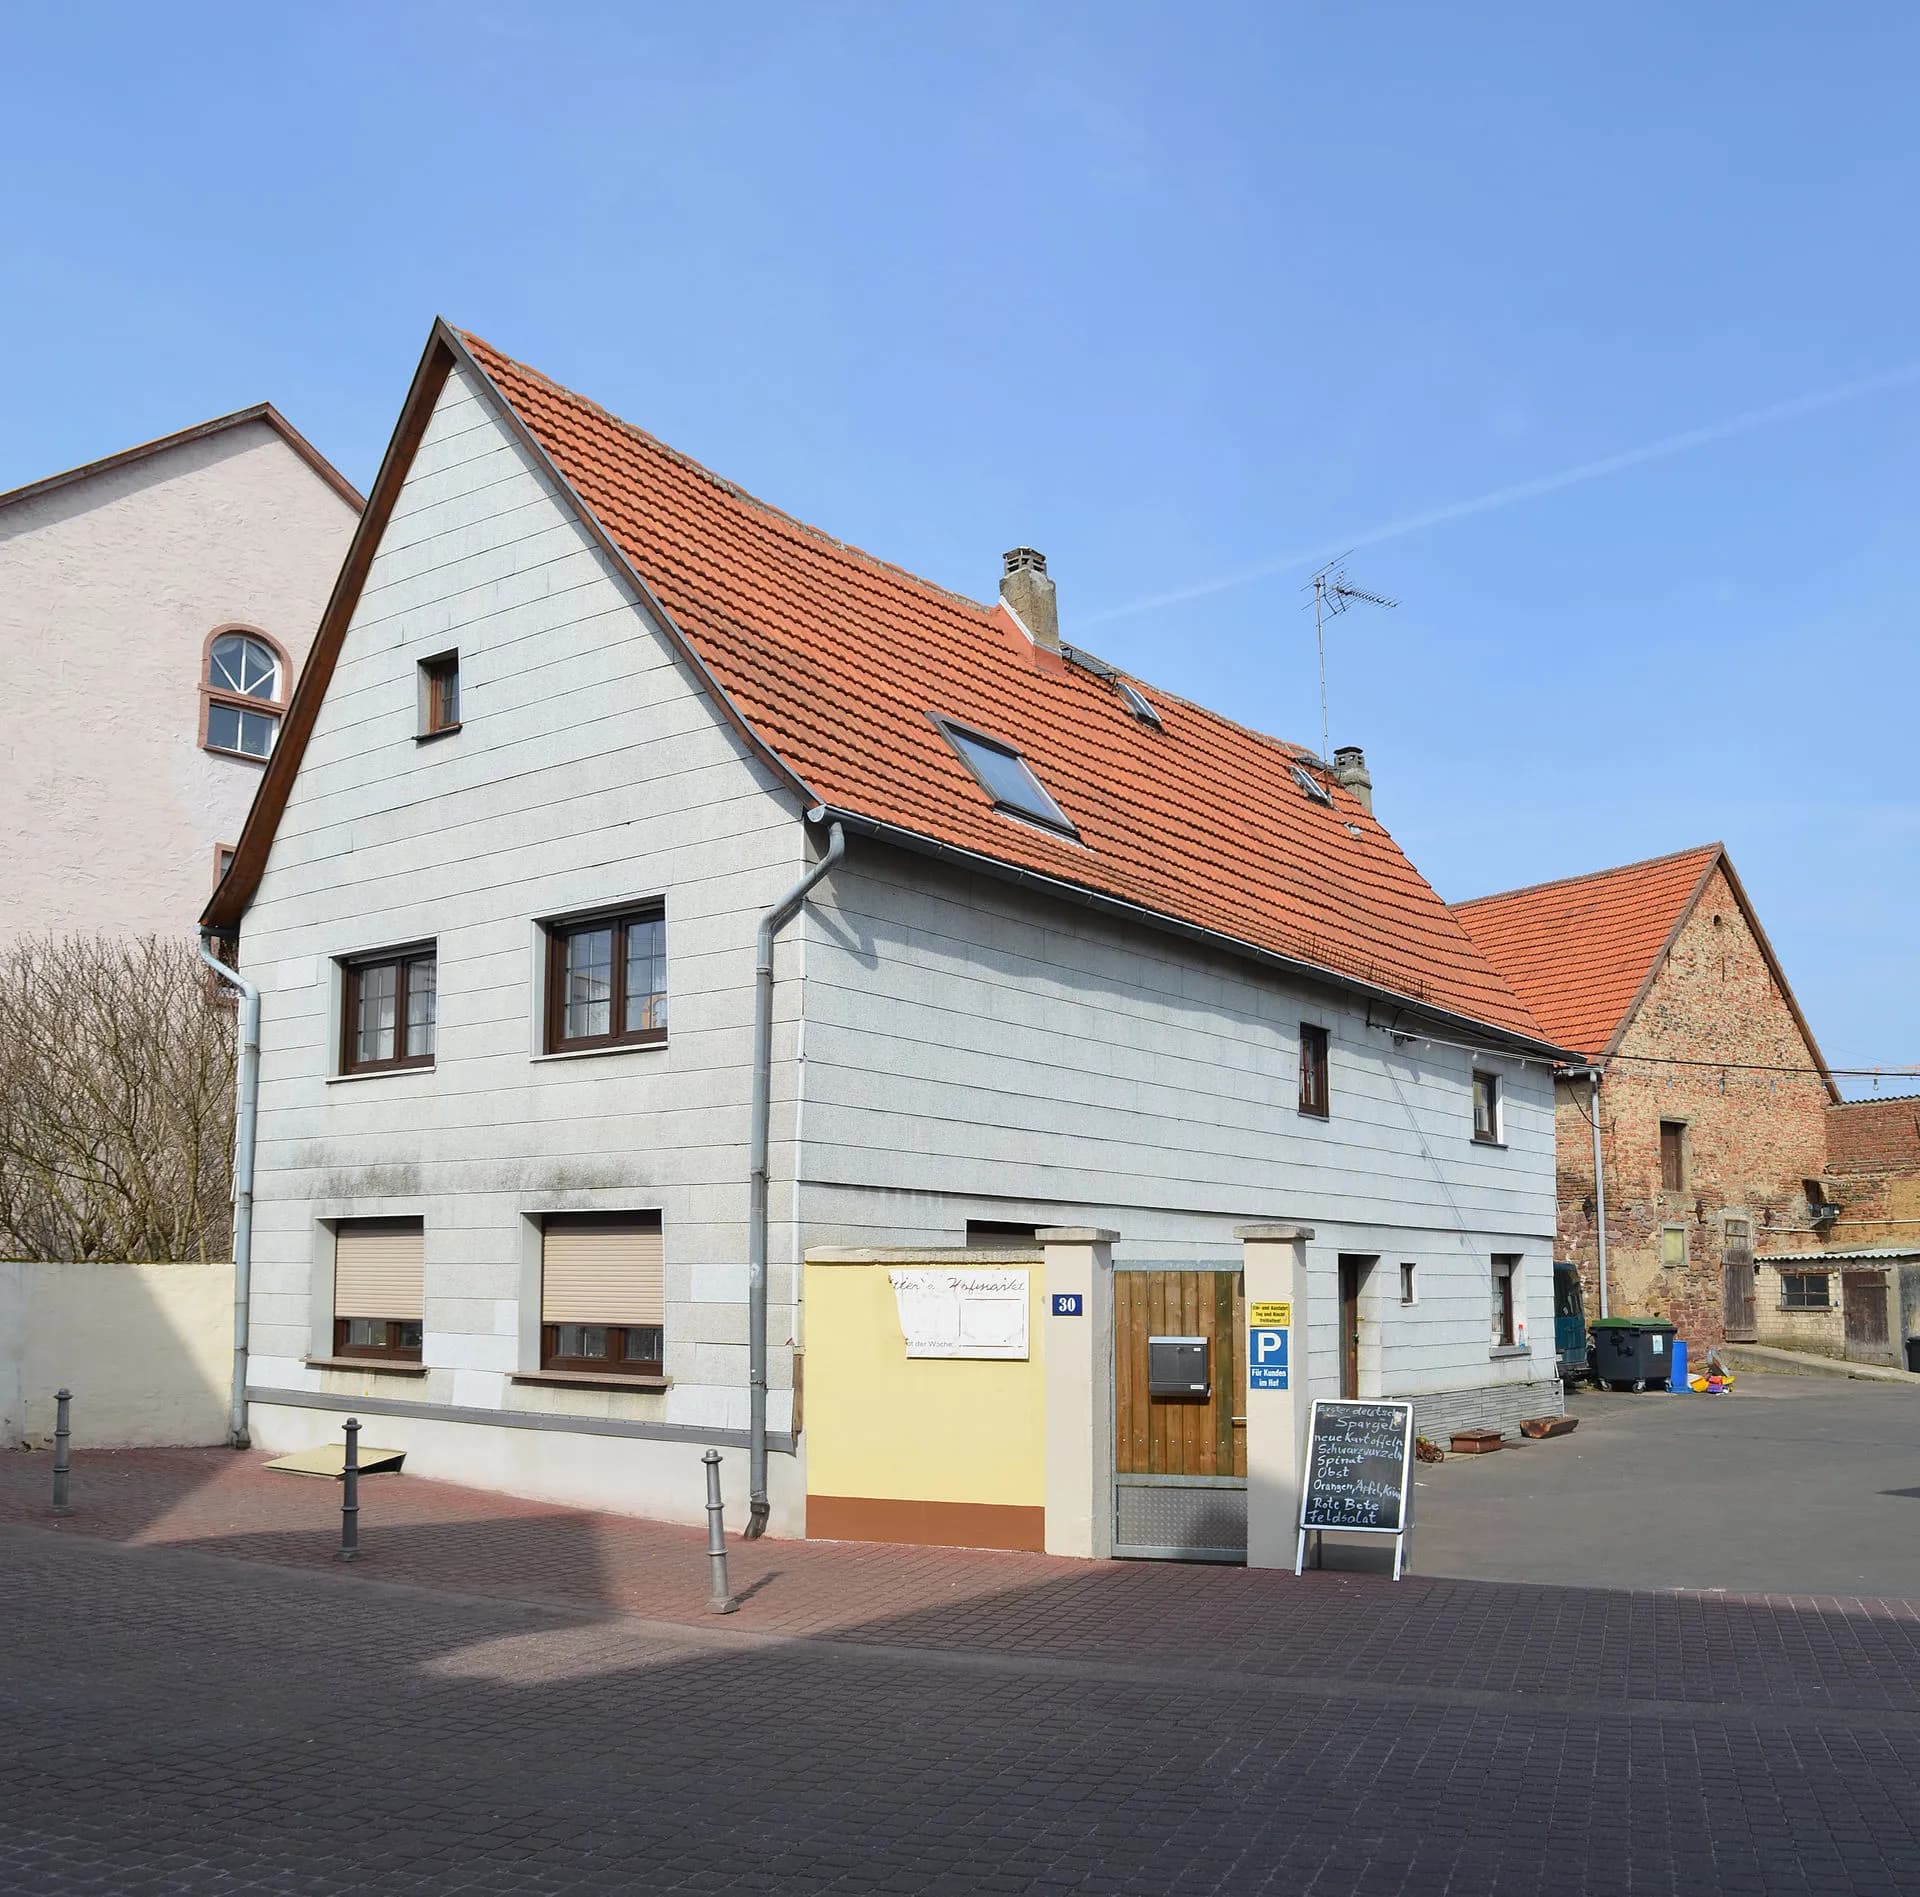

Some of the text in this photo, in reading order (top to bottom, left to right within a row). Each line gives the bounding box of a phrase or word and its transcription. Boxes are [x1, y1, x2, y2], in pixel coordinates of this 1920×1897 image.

[1058, 1297, 1076, 1312] 30
[914, 1339, 927, 1347] der
[1257, 1331, 1282, 1363] P
[1251, 1368, 1287, 1377] Für Kunden
[1258, 1378, 1280, 1387] im Hof
[1335, 1415, 1401, 1434] Spargel
[1314, 1432, 1403, 1449] neue Kartoffeln
[1317, 1455, 1365, 1468] Spinat
[1317, 1466, 1350, 1479] Obst
[1312, 1496, 1380, 1511] Rote Bete
